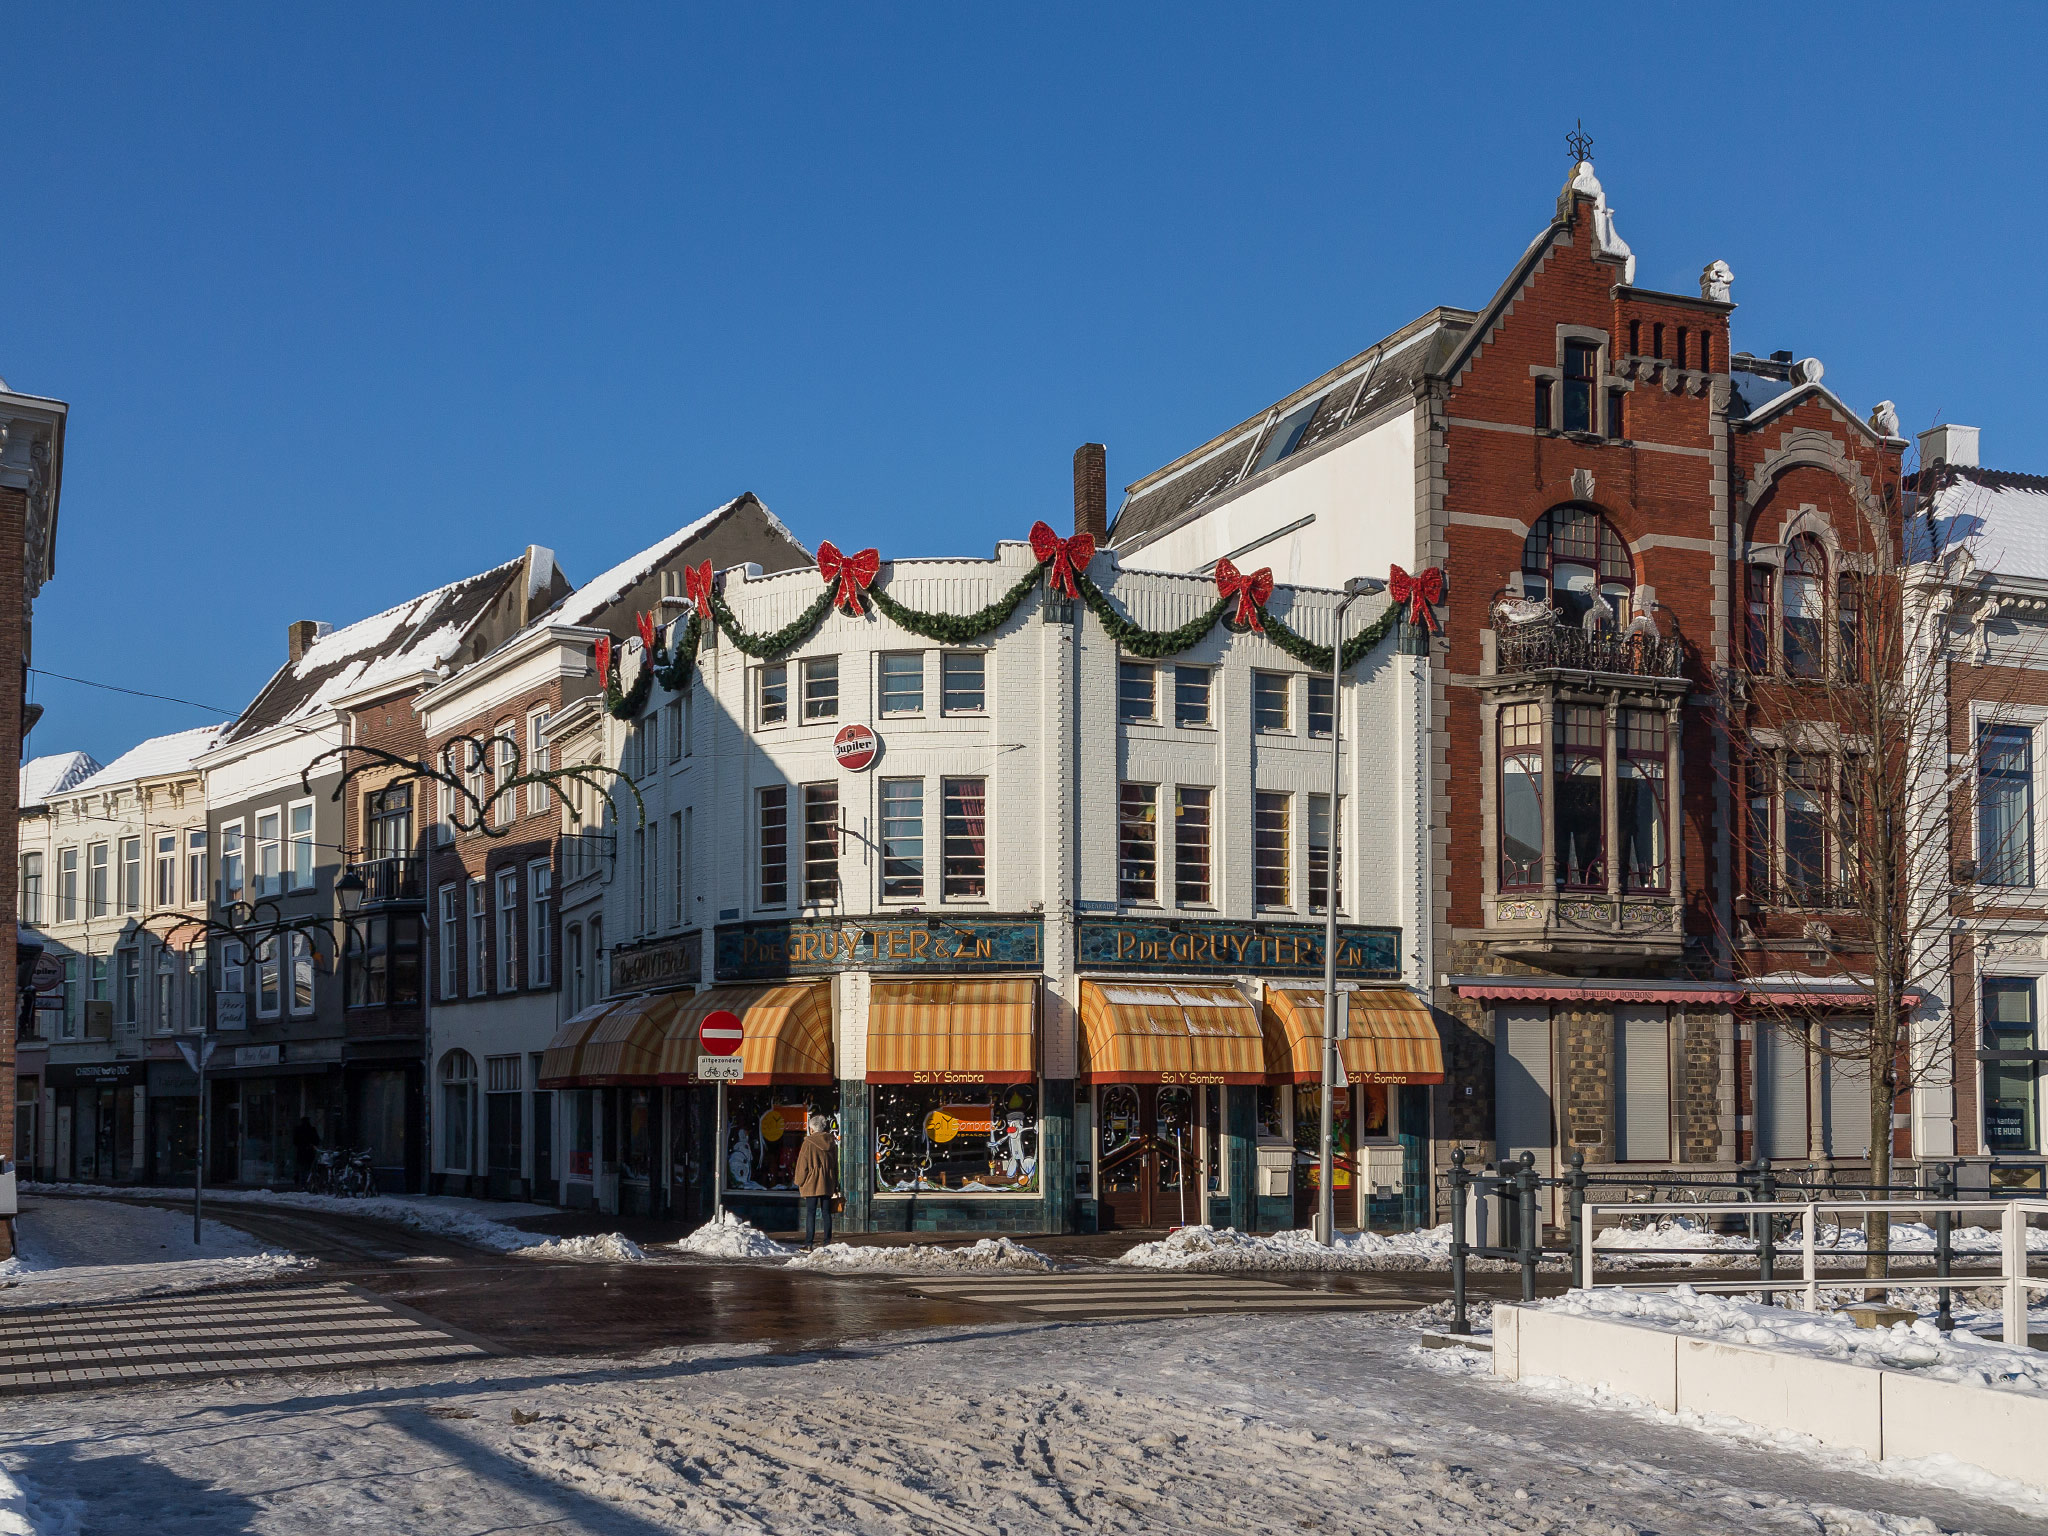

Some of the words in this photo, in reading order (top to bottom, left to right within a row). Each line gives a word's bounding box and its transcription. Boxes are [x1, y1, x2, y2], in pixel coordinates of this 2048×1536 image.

[835, 740, 872, 755] Jupiler
[760, 943, 784, 962] DE
[785, 928, 931, 962] GRUYTER
[934, 938, 950, 958] &
[1116, 930, 1136, 960] P.
[1139, 941, 1169, 961] DE
[1169, 932, 1312, 966] GRUYTER
[913, 1071, 930, 1083] Sol
[933, 1071, 943, 1083] Y
[944, 1071, 985, 1083] Sombra
[1161, 1071, 1177, 1084] Sol
[1179, 1072, 1188, 1084] Y
[1189, 1072, 1225, 1085] Sombra
[1348, 1072, 1362, 1084] Sol
[1363, 1072, 1372, 1084] Y
[1373, 1072, 1407, 1085] Sombra
[941, 1115, 954, 1131] Y
[951, 1118, 992, 1132] Sombra
[1996, 1117, 2021, 1125] kantoor
[1993, 1127, 2003, 1136] TE
[2002, 1127, 2022, 1136] HUUR
